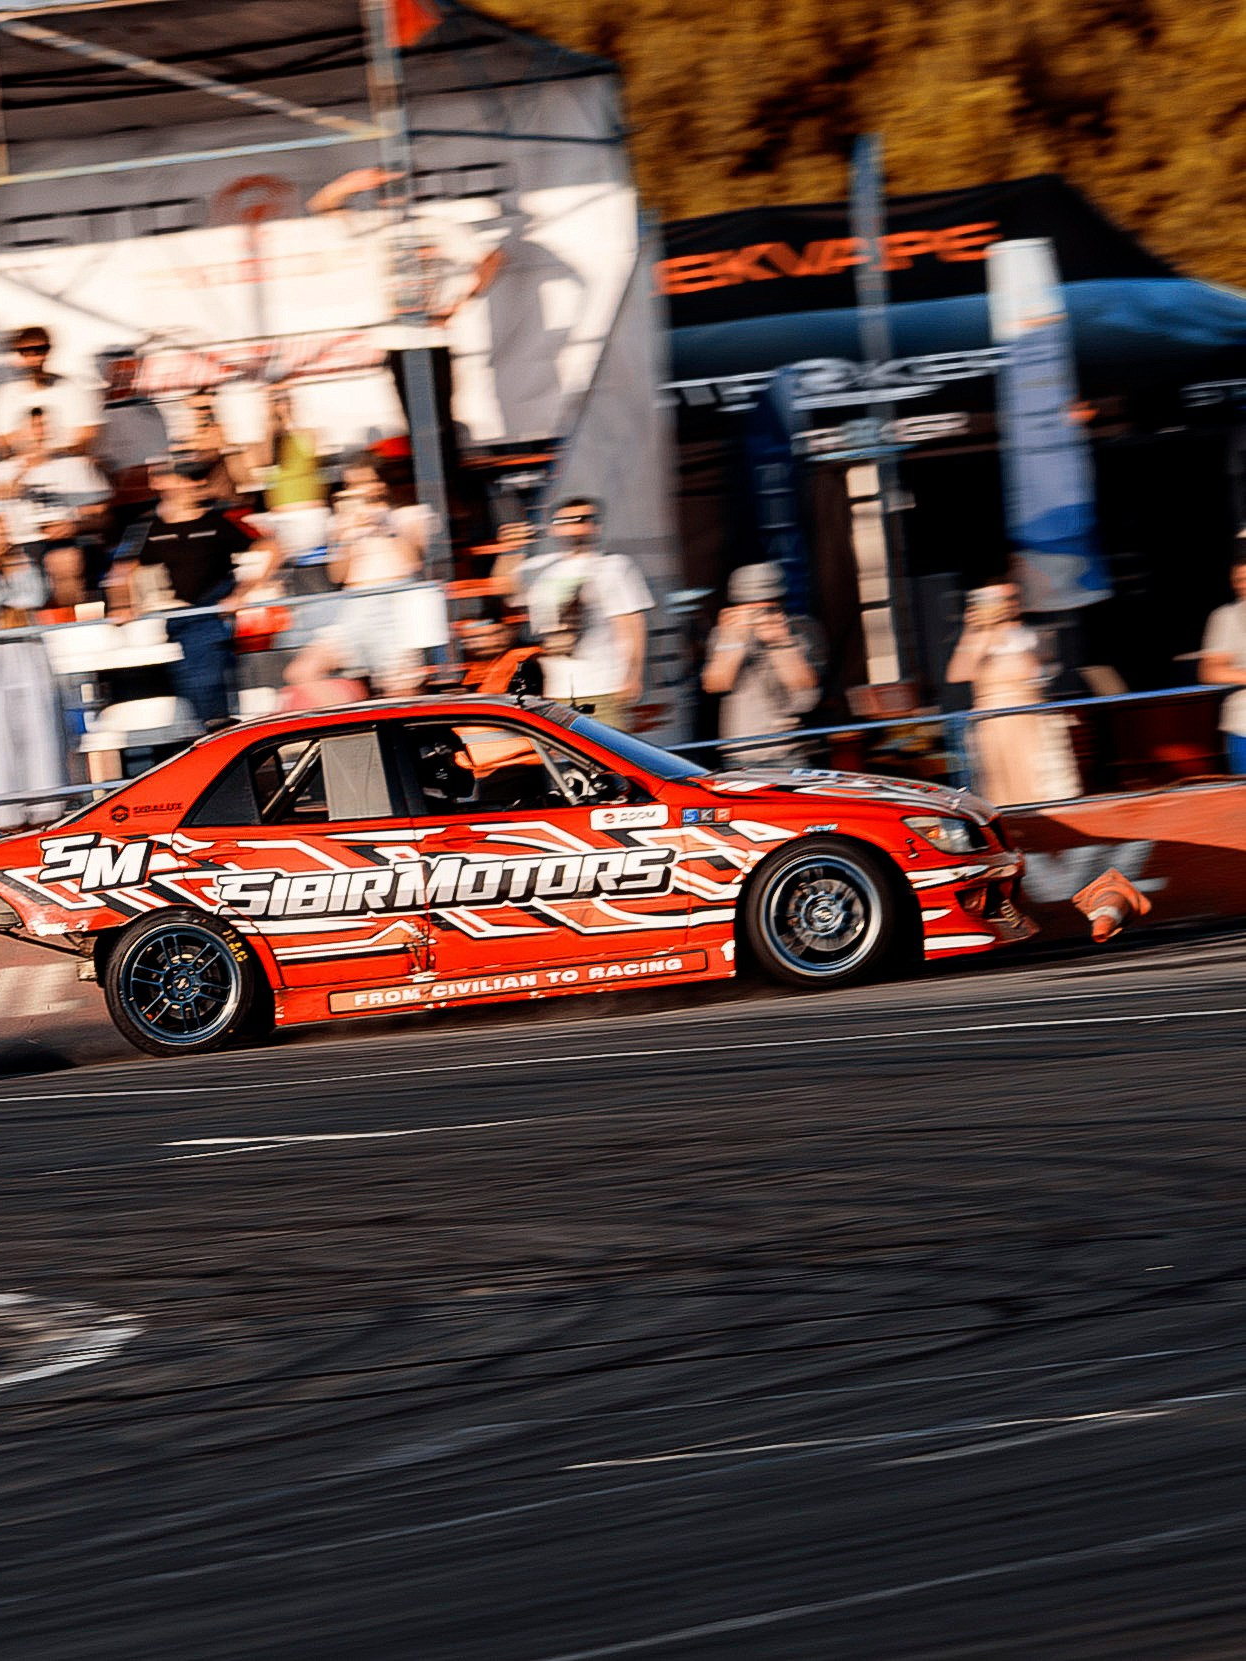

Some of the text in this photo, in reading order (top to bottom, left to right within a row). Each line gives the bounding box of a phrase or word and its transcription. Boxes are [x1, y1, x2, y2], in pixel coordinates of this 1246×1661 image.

[39, 834, 150, 891] SM
[354, 957, 684, 1007] FROM CIVILIAN TO RACING
